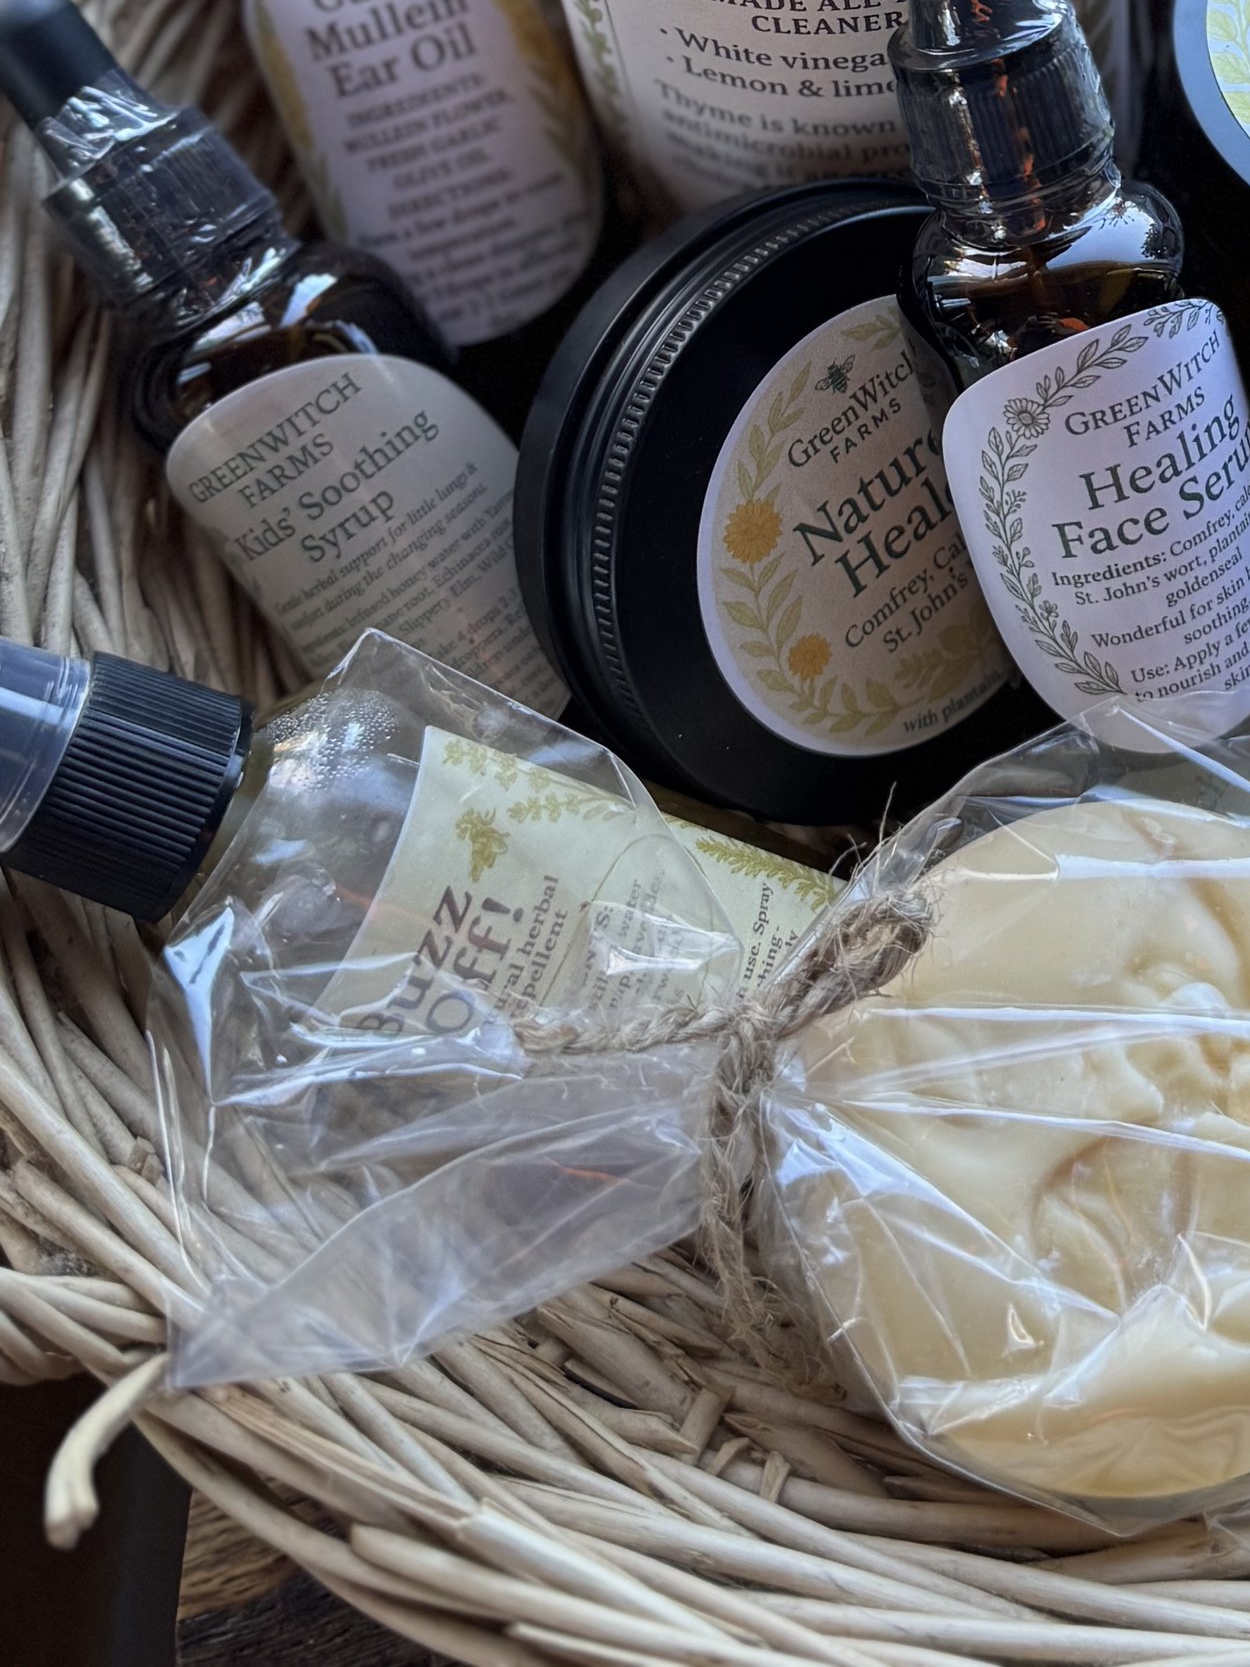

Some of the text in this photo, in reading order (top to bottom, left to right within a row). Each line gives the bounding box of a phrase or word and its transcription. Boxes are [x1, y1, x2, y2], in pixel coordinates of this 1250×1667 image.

[675, 27, 887, 73] White vinega
[752, 11, 906, 35] CLEANER
[328, 23, 476, 99] Ear Oil
[682, 55, 789, 96] Lemon
[798, 80, 824, 97] &
[653, 78, 896, 136] Thyme is known
[1065, 331, 1220, 435] GREENWITCH
[1124, 386, 1206, 447] FARMS
[189, 371, 363, 503] GREENWITCH
[830, 397, 902, 464] FARMS
[1079, 394, 1240, 510] Healing
[235, 410, 440, 562] Kids' Soothing
[238, 432, 334, 509] FARMS
[302, 489, 395, 563] Syrup
[365, 564, 385, 586] the
[386, 518, 447, 570] changing
[388, 520, 408, 545] for
[407, 499, 438, 525] little
[834, 476, 954, 598] Heal
[1051, 506, 1170, 559] Face
[1052, 550, 1167, 588] Ingredients:
[1170, 512, 1235, 557] Comfrey,
[845, 568, 935, 648] Comfrey,
[1075, 591, 1098, 605] St.
[1103, 574, 1160, 602] John's
[1163, 558, 1207, 584] wort,
[1165, 546, 1244, 607] goldenseal
[883, 571, 969, 653] St. John's
[1091, 610, 1187, 649] Wonderful
[1190, 598, 1214, 621] for
[1216, 577, 1246, 605] skin
[1184, 599, 1250, 644] soothing.
[1131, 662, 1170, 683] Use:
[1174, 640, 1221, 674] Apply
[1225, 635, 1234, 646] a
[1157, 660, 1223, 697] nourish
[1225, 644, 1250, 668] and
[903, 709, 939, 733] with
[517, 875, 559, 958] herbal
[743, 942, 761, 981] use.
[752, 882, 774, 937] Spray
[426, 896, 525, 1034] Off!
